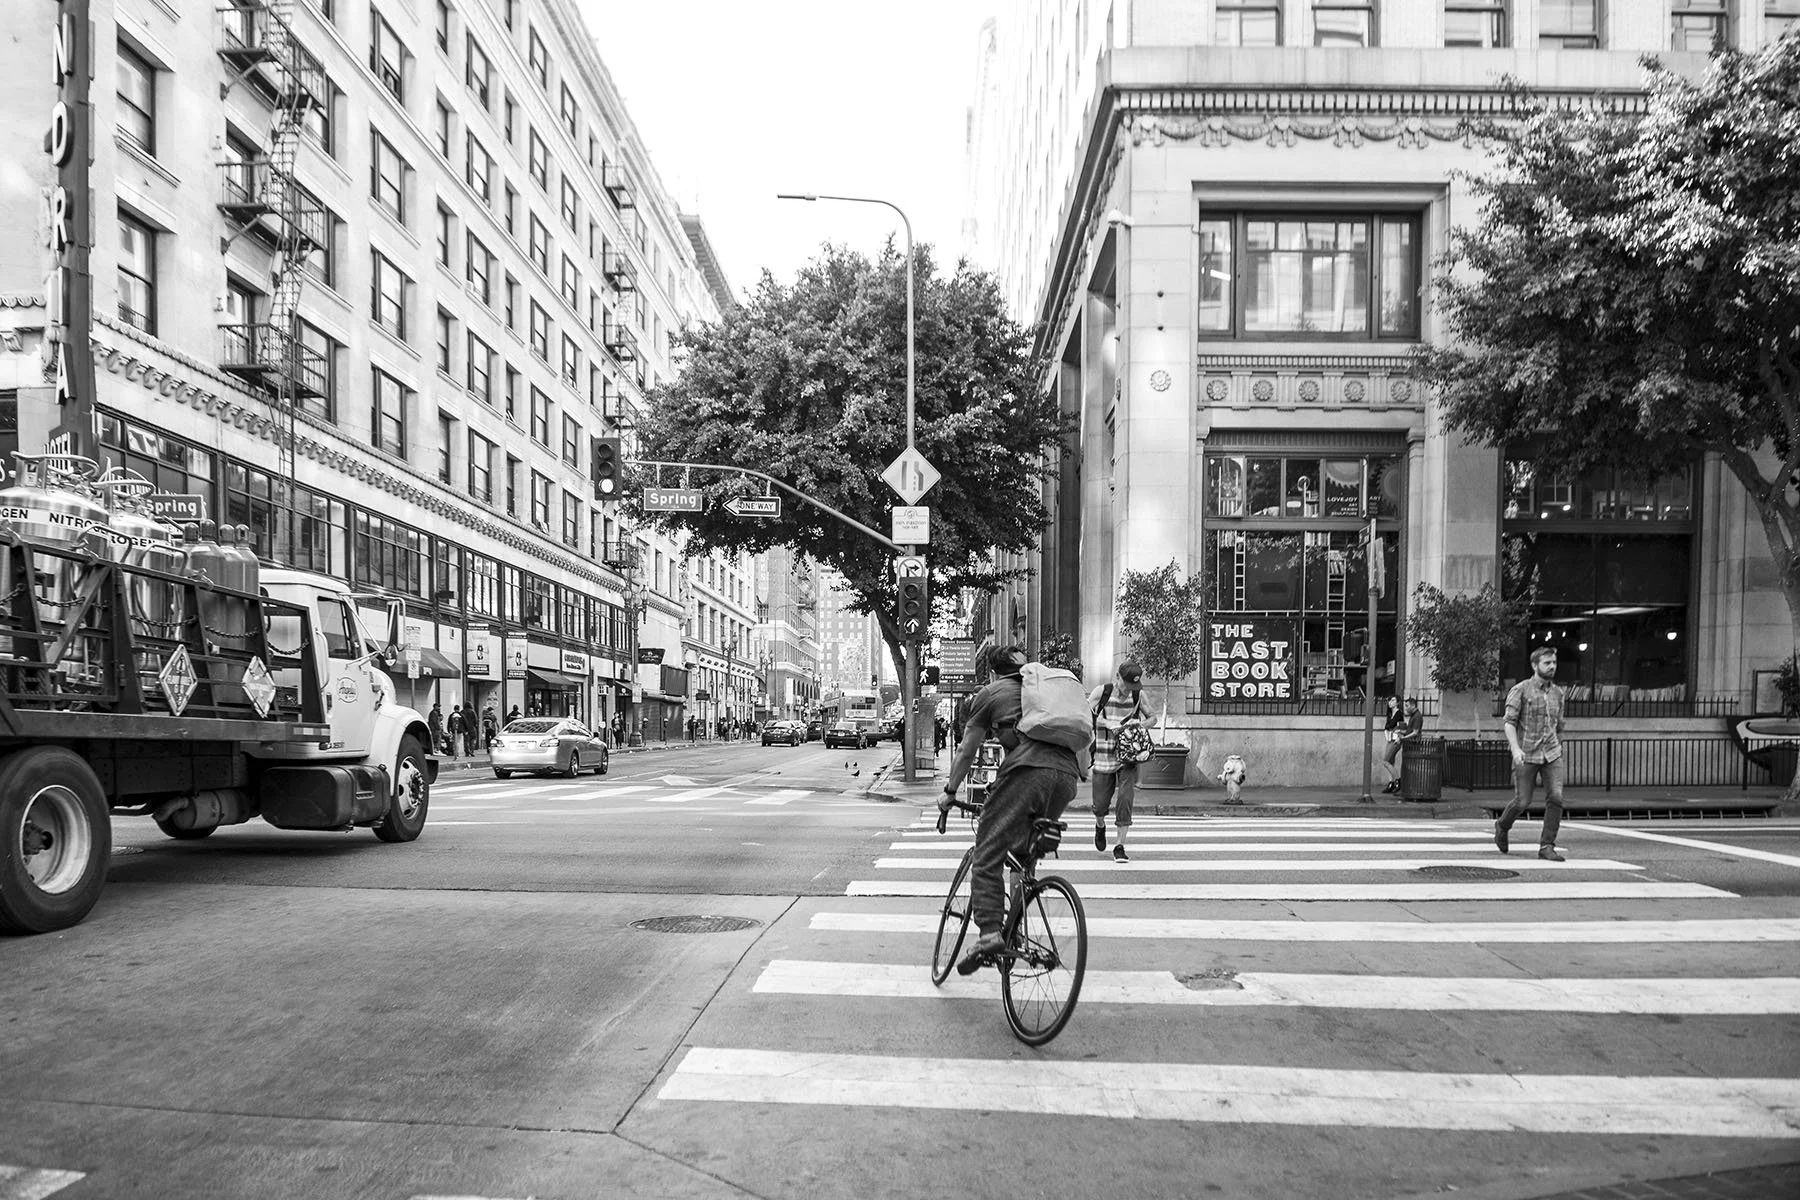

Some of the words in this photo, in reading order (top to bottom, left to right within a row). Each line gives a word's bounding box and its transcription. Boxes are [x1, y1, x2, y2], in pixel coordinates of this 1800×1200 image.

[146, 498, 197, 516] Spring
[650, 492, 696, 508] Spring
[740, 501, 756, 510] ONE
[757, 502, 774, 510] WAY
[0, 508, 29, 519] GEN
[1211, 623, 1254, 638] THE
[1211, 640, 1288, 660] LAST
[1211, 661, 1288, 680] BOOK
[1210, 681, 1291, 698] STORE
